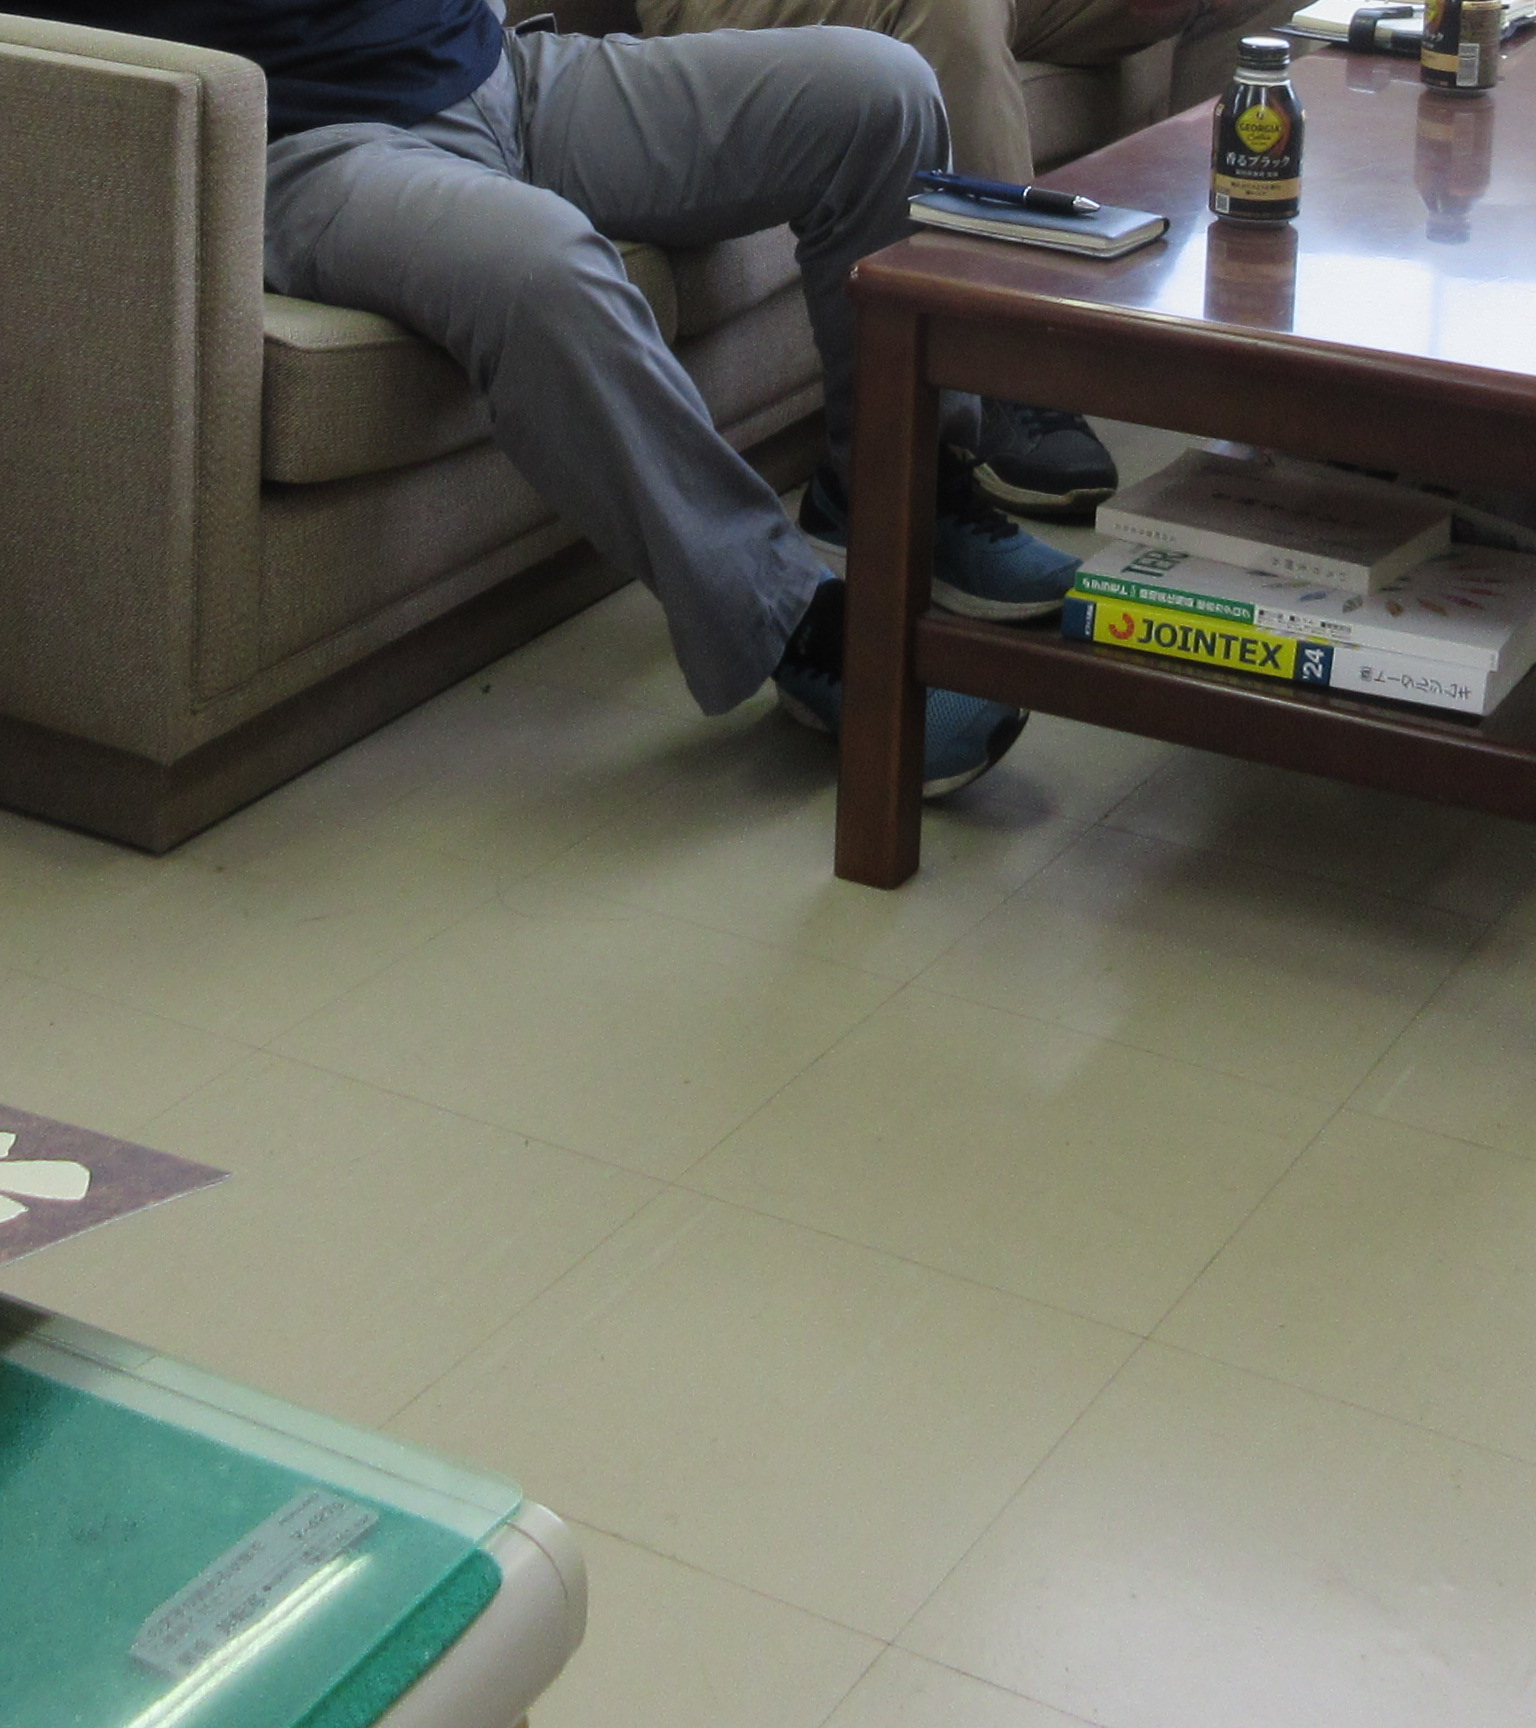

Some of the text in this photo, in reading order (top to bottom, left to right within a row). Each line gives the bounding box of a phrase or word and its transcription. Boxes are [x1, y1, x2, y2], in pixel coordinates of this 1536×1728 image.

[1237, 122, 1282, 134] GEORGIA
[1225, 151, 1291, 168] 香るブラック
[1136, 617, 1283, 671] JOINTEX
